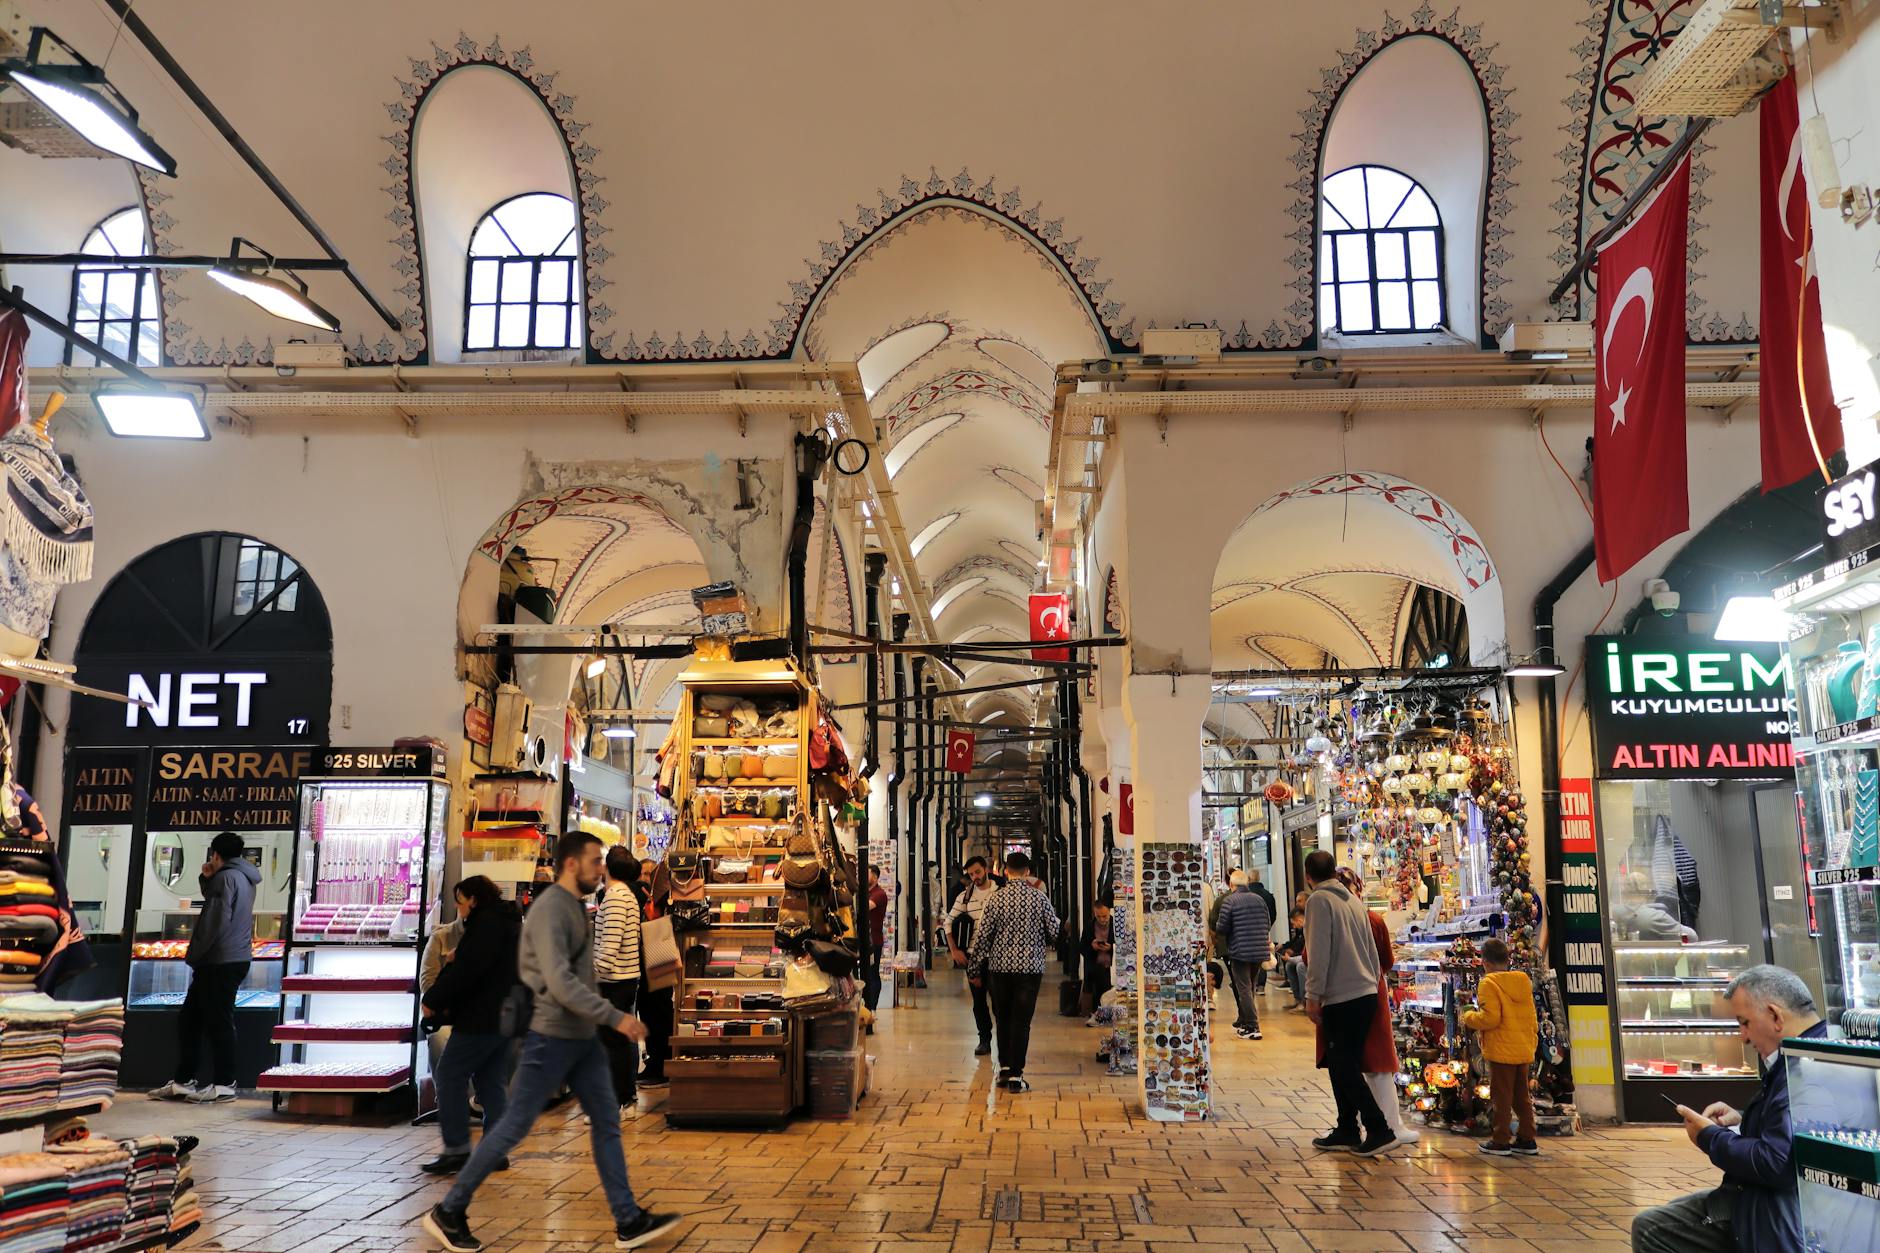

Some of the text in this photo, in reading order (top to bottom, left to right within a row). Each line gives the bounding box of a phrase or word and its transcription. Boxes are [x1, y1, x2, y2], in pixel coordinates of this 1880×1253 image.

[11, 458, 36, 484] DIOR
[1824, 472, 1876, 537] SEY
[1824, 551, 1868, 580] SILVER 925
[1790, 624, 1815, 640] SILVER
[126, 672, 267, 727] NET
[1611, 697, 1798, 715] KUYUMCULUK
[287, 719, 307, 734] 17
[1816, 722, 1859, 743] SILVER 925
[159, 752, 312, 780] SARRAF
[324, 754, 417, 769] 925 SILVER
[1613, 744, 1700, 769] ALTIN
[76, 767, 135, 786] ALTIN
[73, 793, 133, 812] ALINIR
[152, 787, 193, 803] ALTIN
[202, 787, 237, 802] SAAT
[1560, 792, 1590, 816] LTIN
[169, 810, 222, 826] ALINIR
[233, 809, 292, 825] SATILIR
[1560, 819, 1592, 840] LINIR
[1816, 868, 1860, 884] SILVER 925
[1566, 972, 1604, 994] ALINIR
[1804, 1167, 1849, 1191] SILVER 925
[1861, 1182, 1880, 1200] SILV
